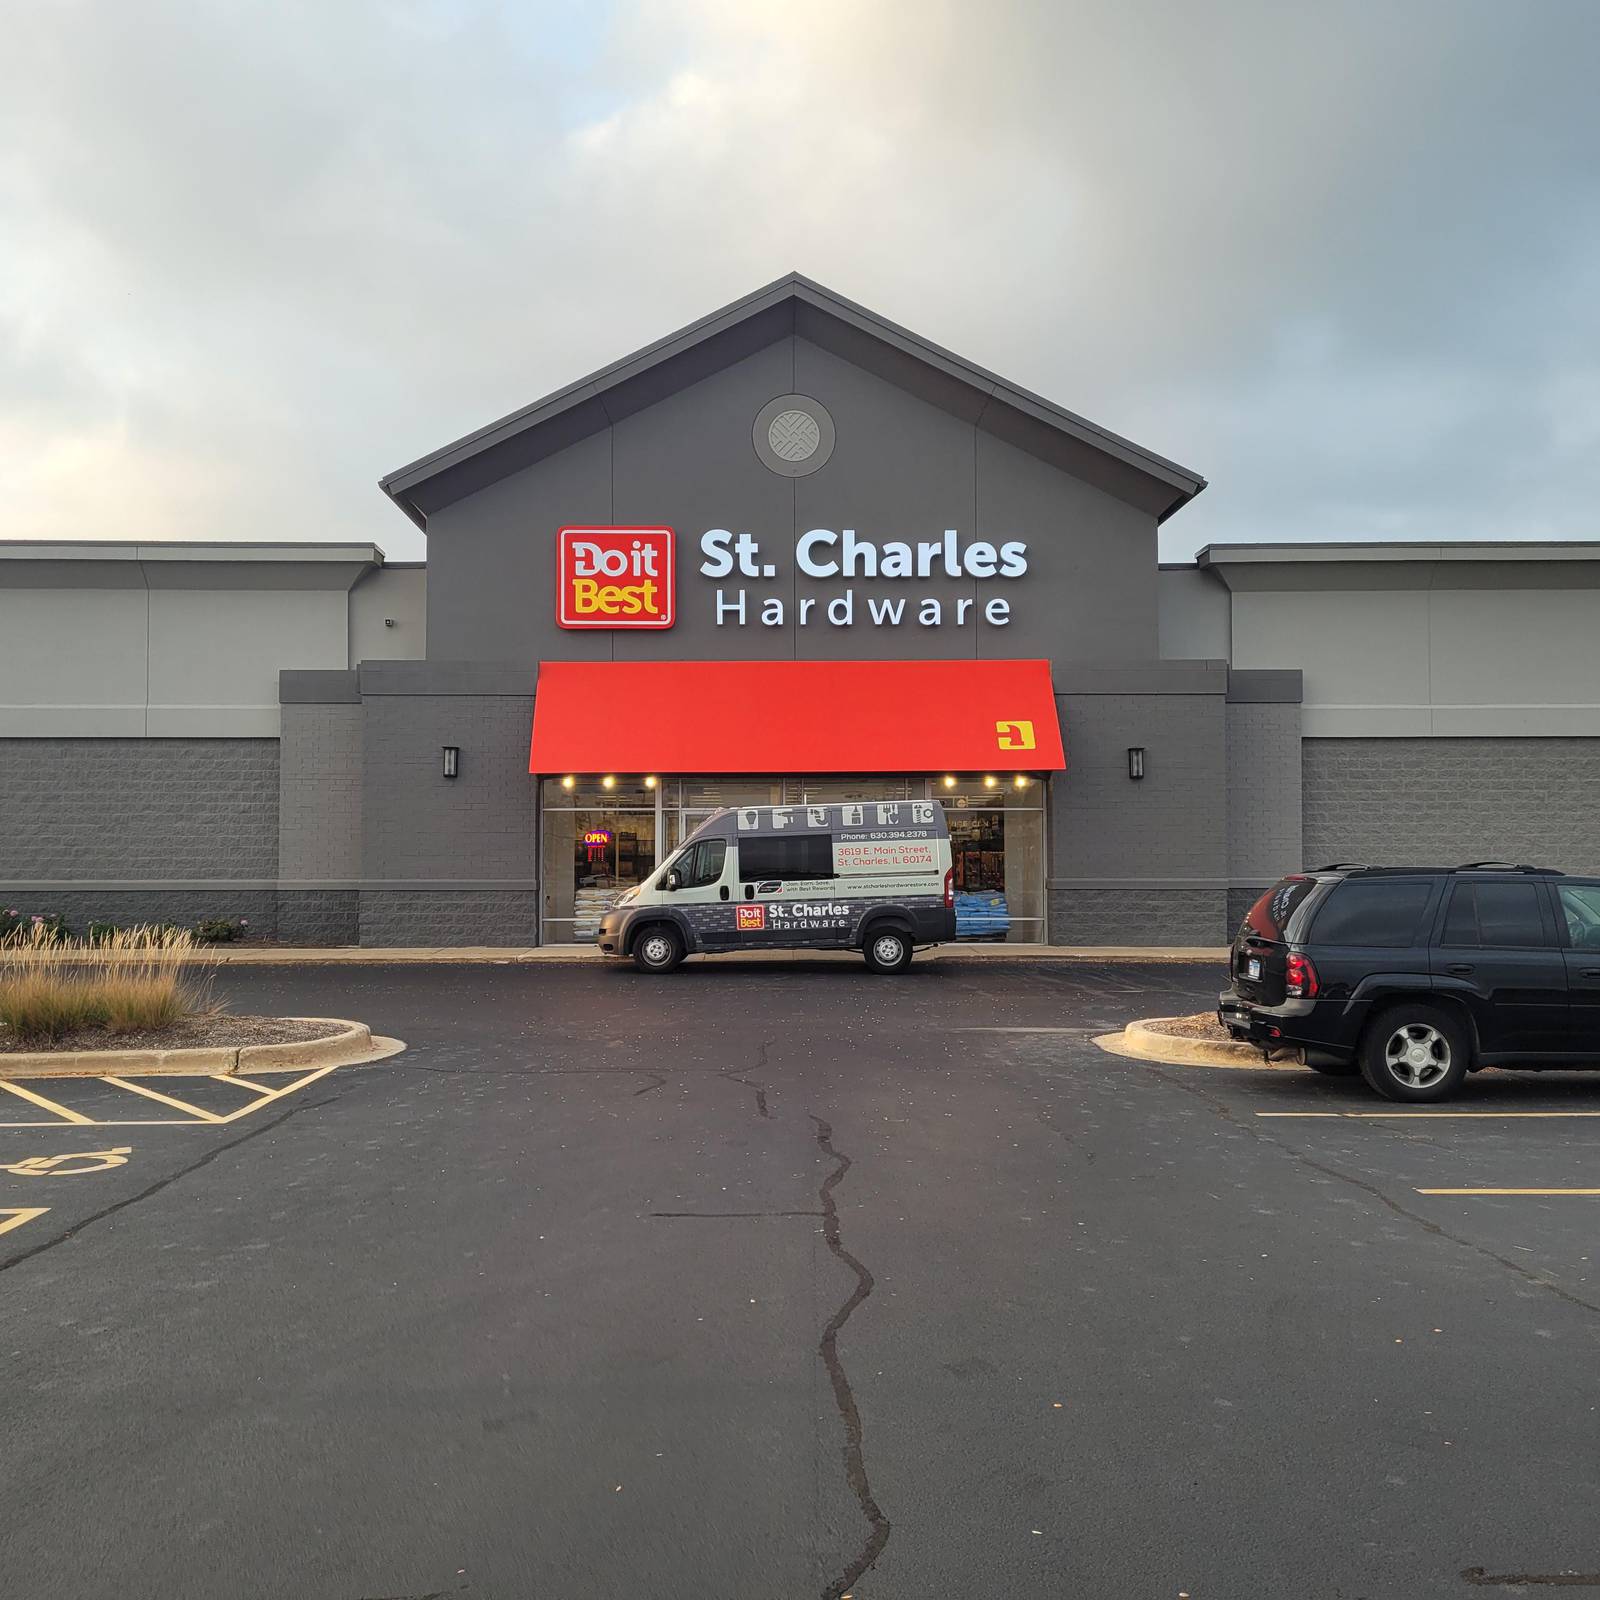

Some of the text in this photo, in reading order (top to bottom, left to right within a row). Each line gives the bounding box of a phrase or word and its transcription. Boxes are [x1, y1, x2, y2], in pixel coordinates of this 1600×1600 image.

[700, 529, 1028, 577] St. Charles
[573, 540, 658, 577] Do it
[573, 579, 658, 615] Best
[716, 590, 1010, 625] Hardware
[585, 833, 607, 842] OPEN
[870, 831, 927, 839] 630.394.2378
[838, 858, 851, 866] St.
[903, 856, 931, 864] 60174
[847, 881, 939, 889] www.stcharleshardwarestore.com
[769, 903, 849, 918] St. Charles
[740, 918, 761, 927] Best
[773, 919, 845, 929] Hardware
